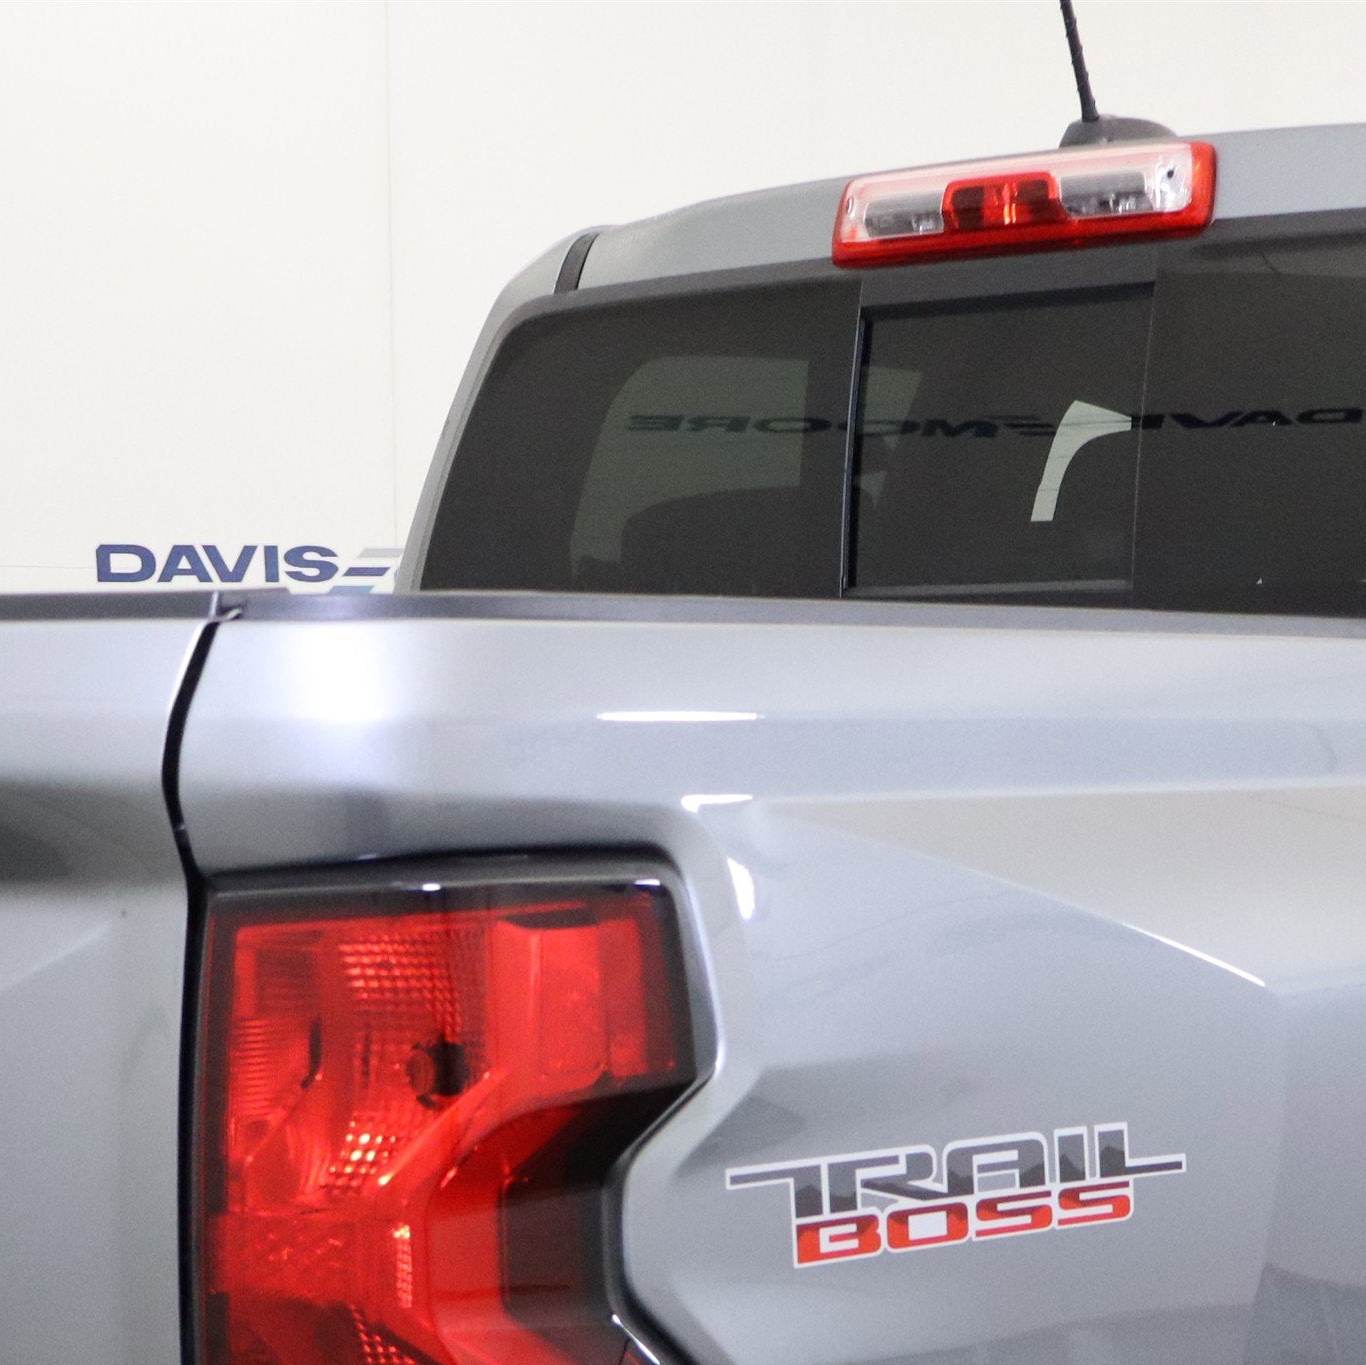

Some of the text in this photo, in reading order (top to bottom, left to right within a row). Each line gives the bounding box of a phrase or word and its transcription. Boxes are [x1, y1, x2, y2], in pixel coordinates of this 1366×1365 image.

[96, 544, 339, 583] DAVIS
[726, 1122, 1186, 1219] TRAIL
[794, 1181, 1133, 1268] BOSS
